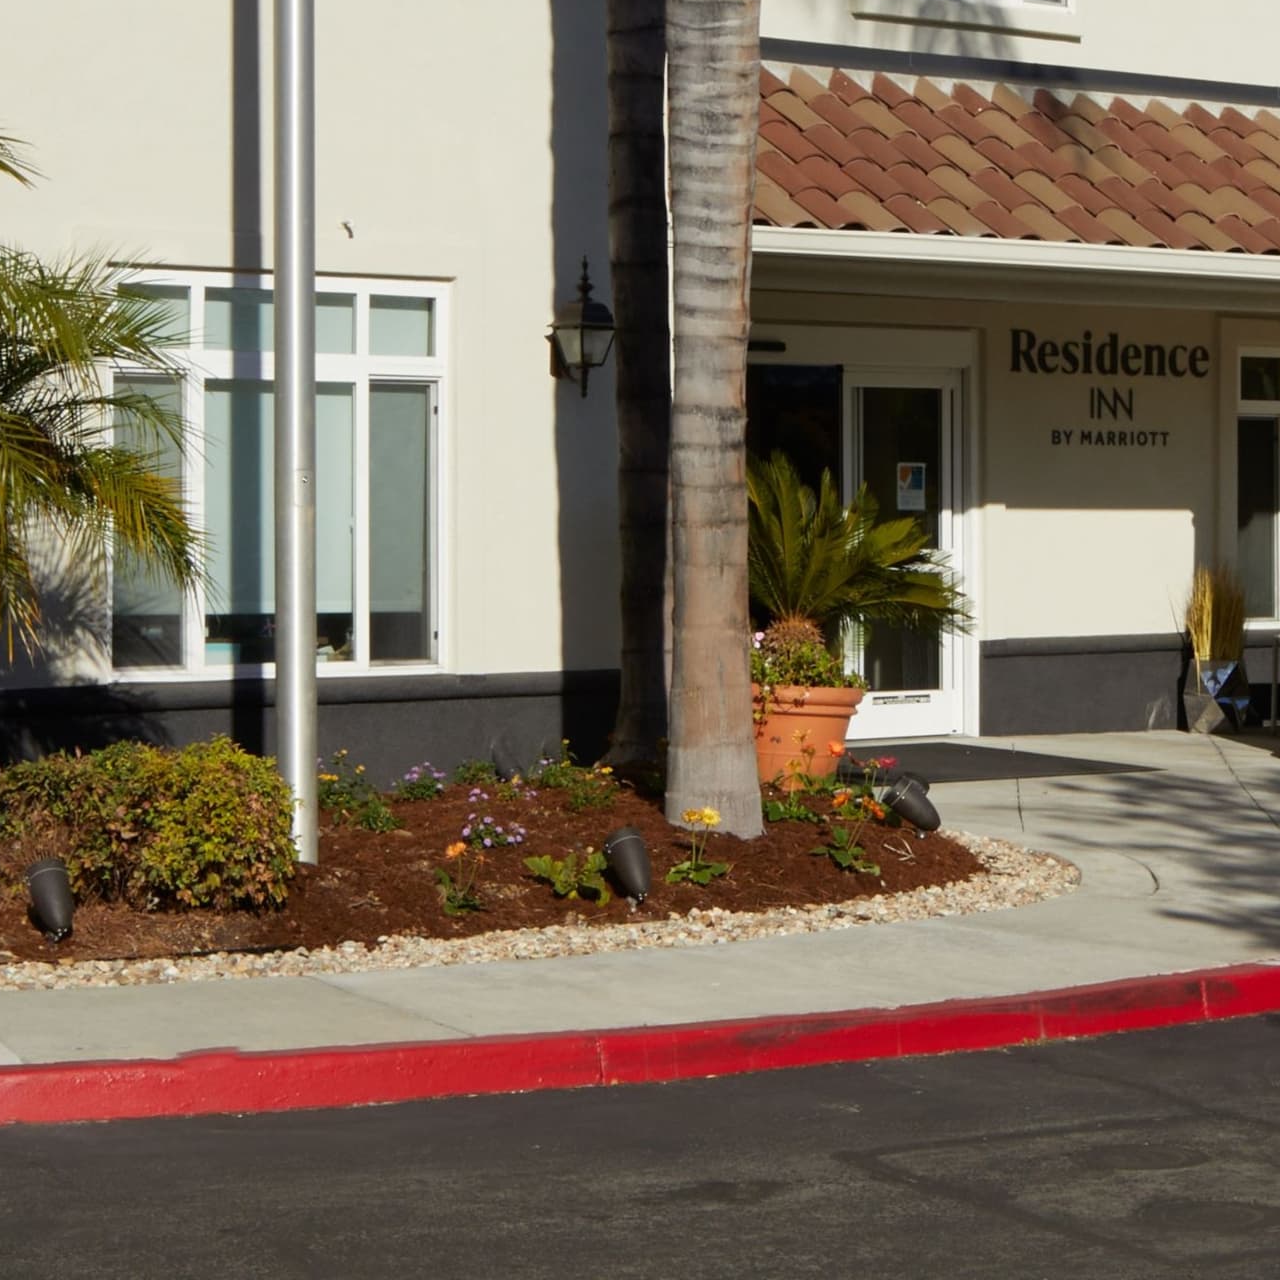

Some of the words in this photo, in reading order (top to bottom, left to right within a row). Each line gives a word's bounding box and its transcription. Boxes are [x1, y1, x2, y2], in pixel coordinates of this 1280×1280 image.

[1010, 329, 1210, 378] Residence
[1090, 388, 1133, 421] INN
[1051, 430, 1073, 446] BY
[1080, 431, 1169, 447] MARRIOTT
